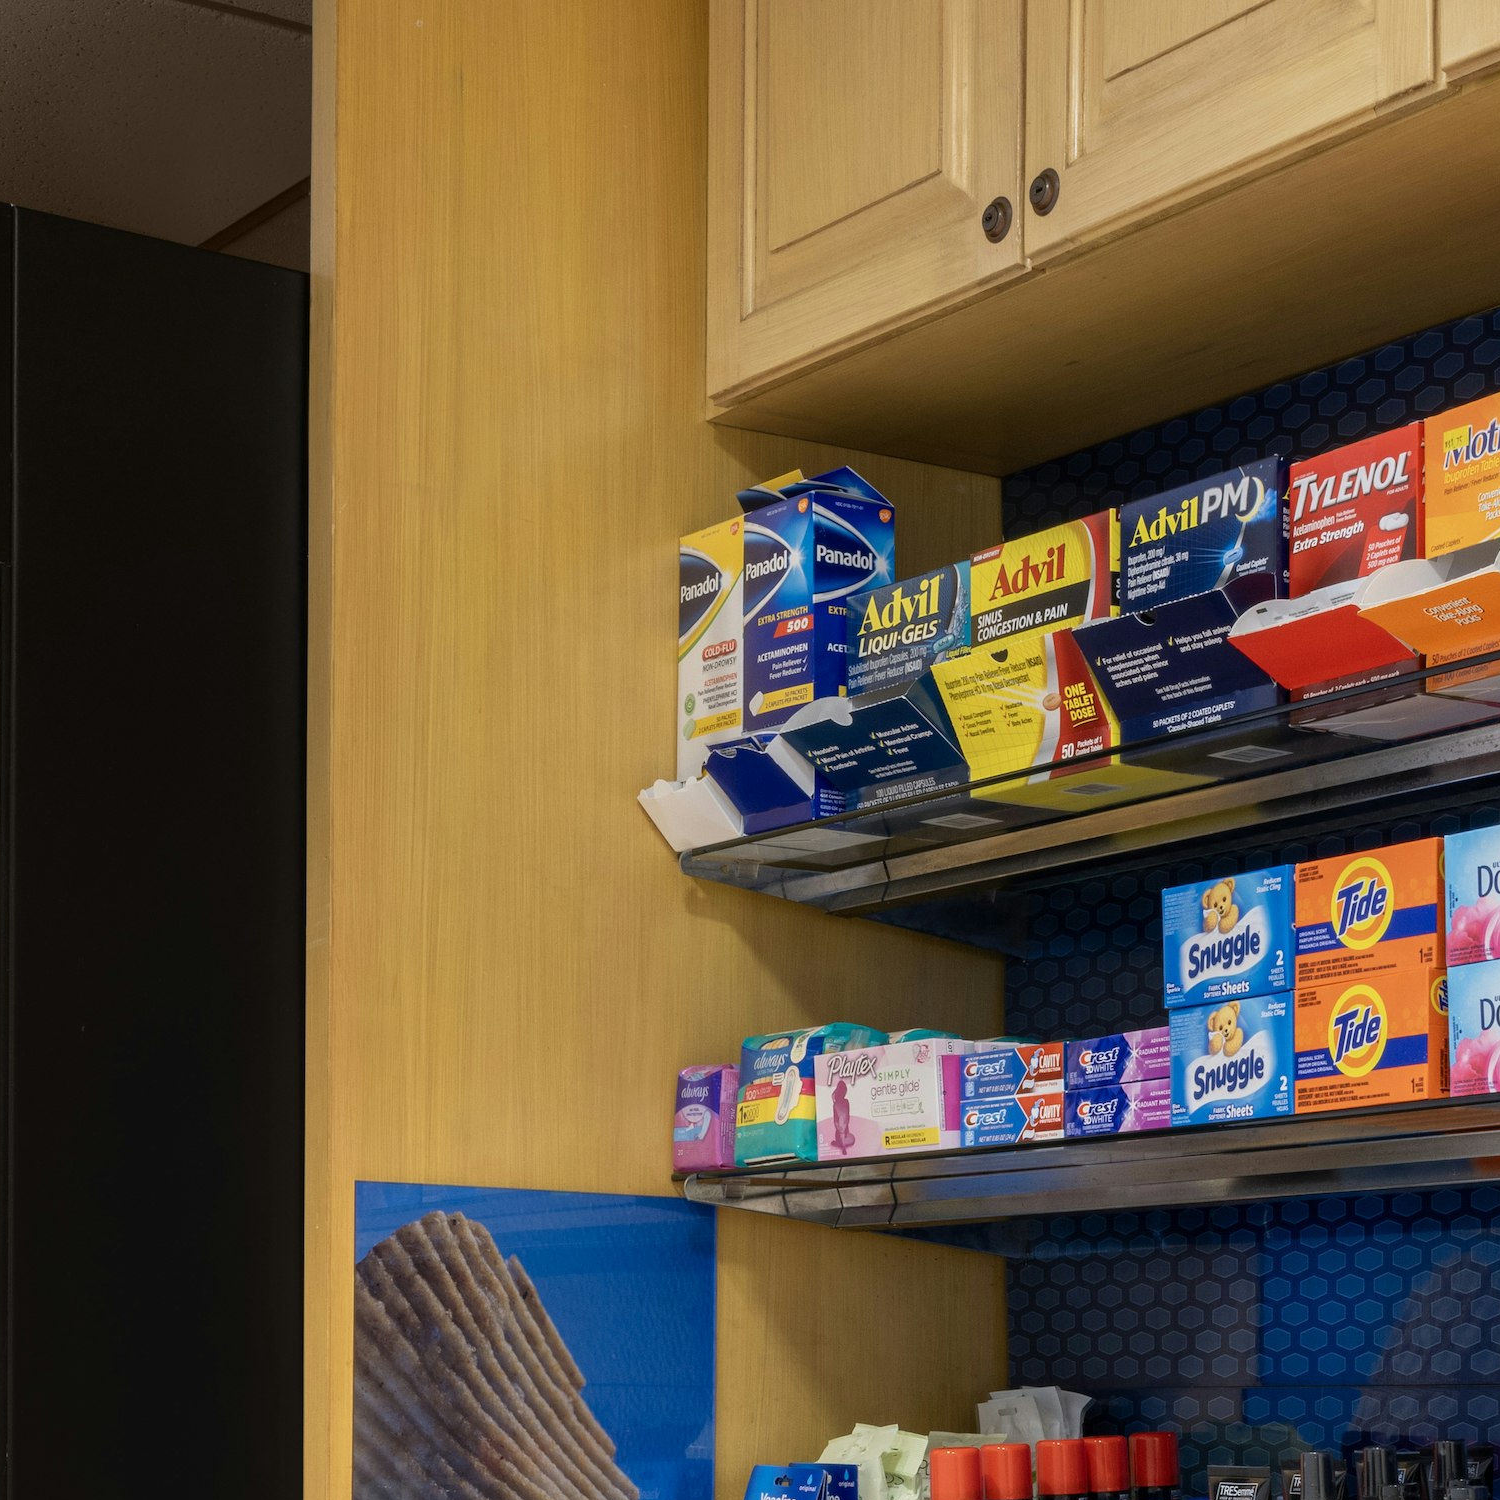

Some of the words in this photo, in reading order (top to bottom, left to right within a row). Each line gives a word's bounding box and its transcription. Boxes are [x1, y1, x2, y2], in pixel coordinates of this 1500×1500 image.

[1293, 451, 1409, 521] TYLENOL
[1129, 496, 1198, 548] Advil
[1201, 476, 1249, 524] PM
[1293, 537, 1317, 554] Extra
[1320, 520, 1364, 545] Strength
[745, 550, 788, 582] Panadol
[816, 544, 873, 570] Panadol
[989, 544, 1066, 602] Advil
[680, 572, 719, 603] Panadol
[758, 614, 775, 626] EXTRA
[776, 605, 808, 621] STRENGTH
[857, 575, 940, 636] Advil
[786, 617, 808, 633] 500
[977, 610, 1003, 629] SINUS
[977, 612, 1033, 642] CONGESTION
[1035, 612, 1043, 623] &
[1044, 603, 1068, 620] PAIN
[704, 641, 735, 659] COLD-FLU
[757, 643, 808, 663] ACETAMINOPHEN
[1102, 657, 1112, 666] For
[1133, 643, 1162, 657] occasional
[1064, 682, 1086, 698] ONE
[1063, 694, 1094, 710] TABLET
[1070, 706, 1096, 722] DOSE!
[1335, 877, 1388, 939] Tide
[1188, 924, 1260, 979] Snuggle
[1221, 980, 1250, 996] Sheets
[754, 1053, 789, 1072] always
[1039, 1053, 1061, 1069] CAVITY
[1079, 1047, 1119, 1066] Crest
[827, 1054, 877, 1086] Playtex
[876, 1069, 911, 1082] SIMPLY
[965, 1058, 1006, 1078] Crest
[681, 1084, 710, 1102] always
[871, 1082, 897, 1100] gentle
[900, 1080, 920, 1096] glide
[1219, 1485, 1254, 1497] TRESemmé
